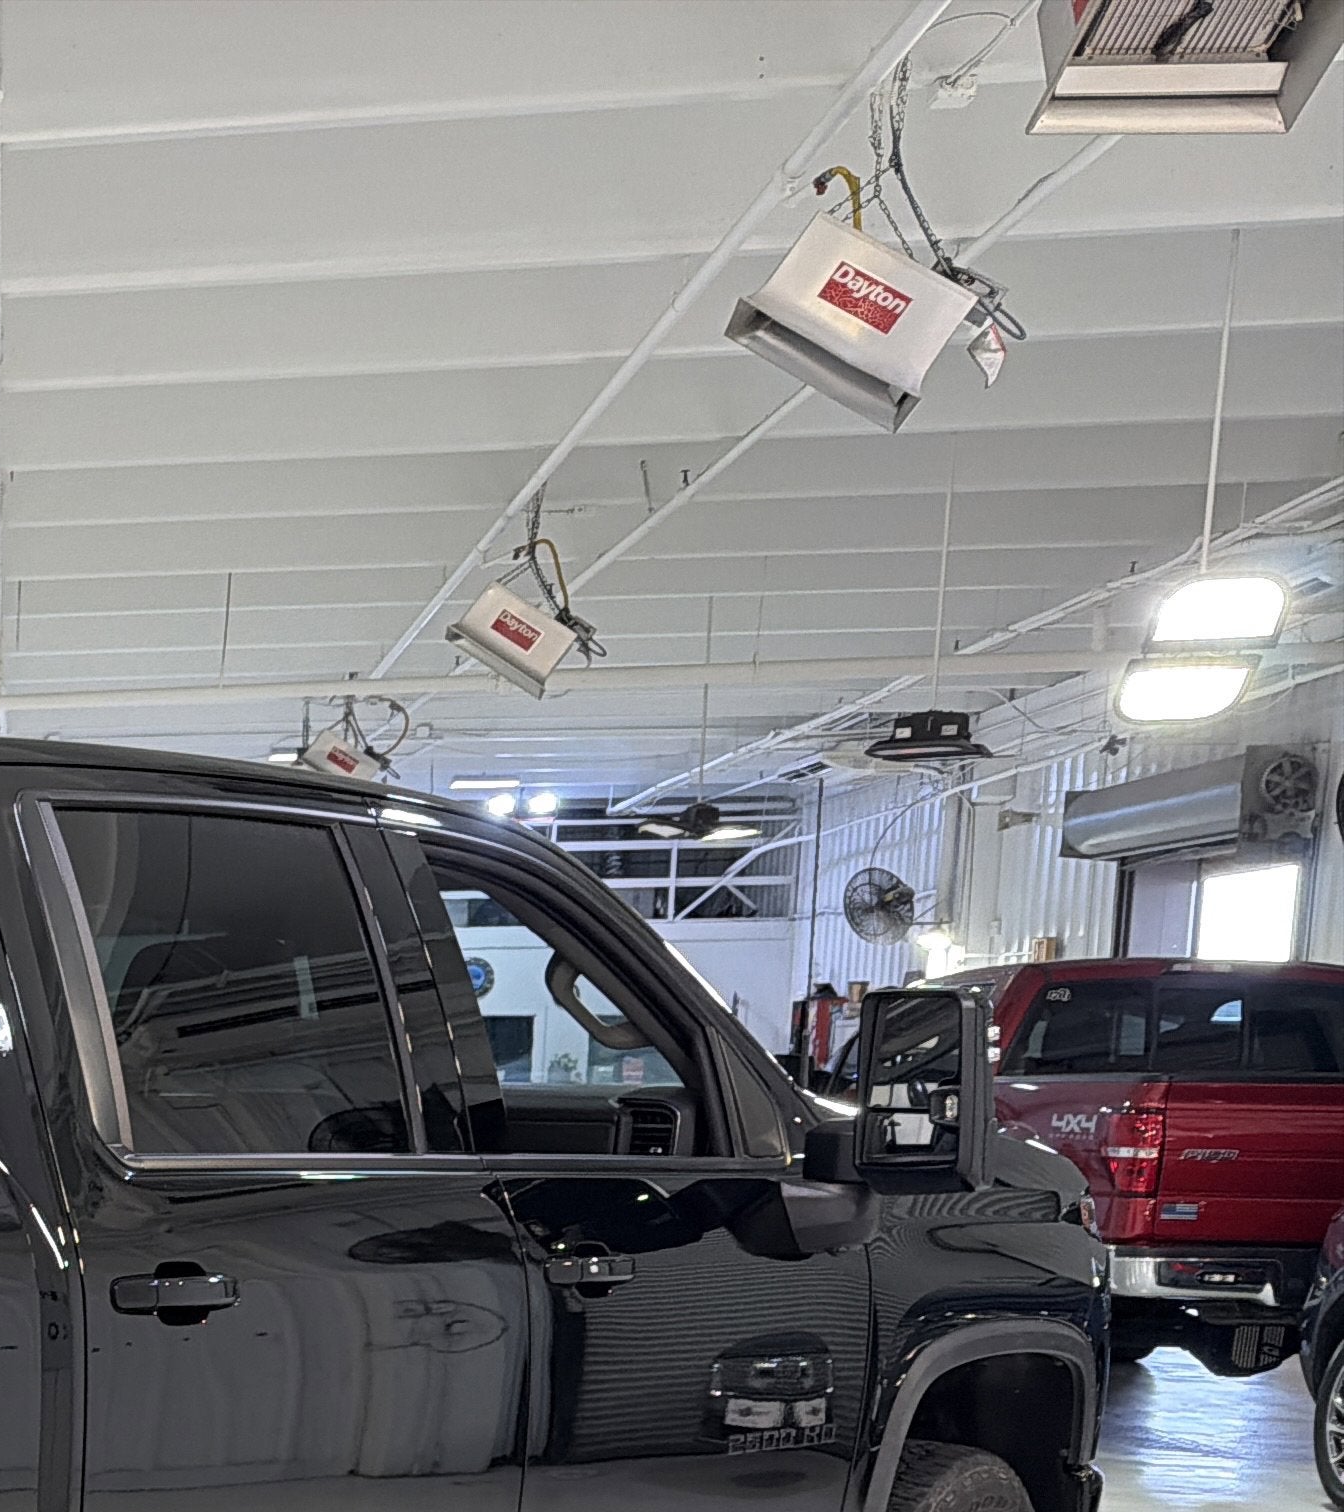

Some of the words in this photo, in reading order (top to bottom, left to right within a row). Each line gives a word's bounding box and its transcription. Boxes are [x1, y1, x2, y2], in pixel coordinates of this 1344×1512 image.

[832, 264, 906, 314] Dayton
[499, 612, 538, 641] Dayton
[1051, 1113, 1098, 1133] 4X4
